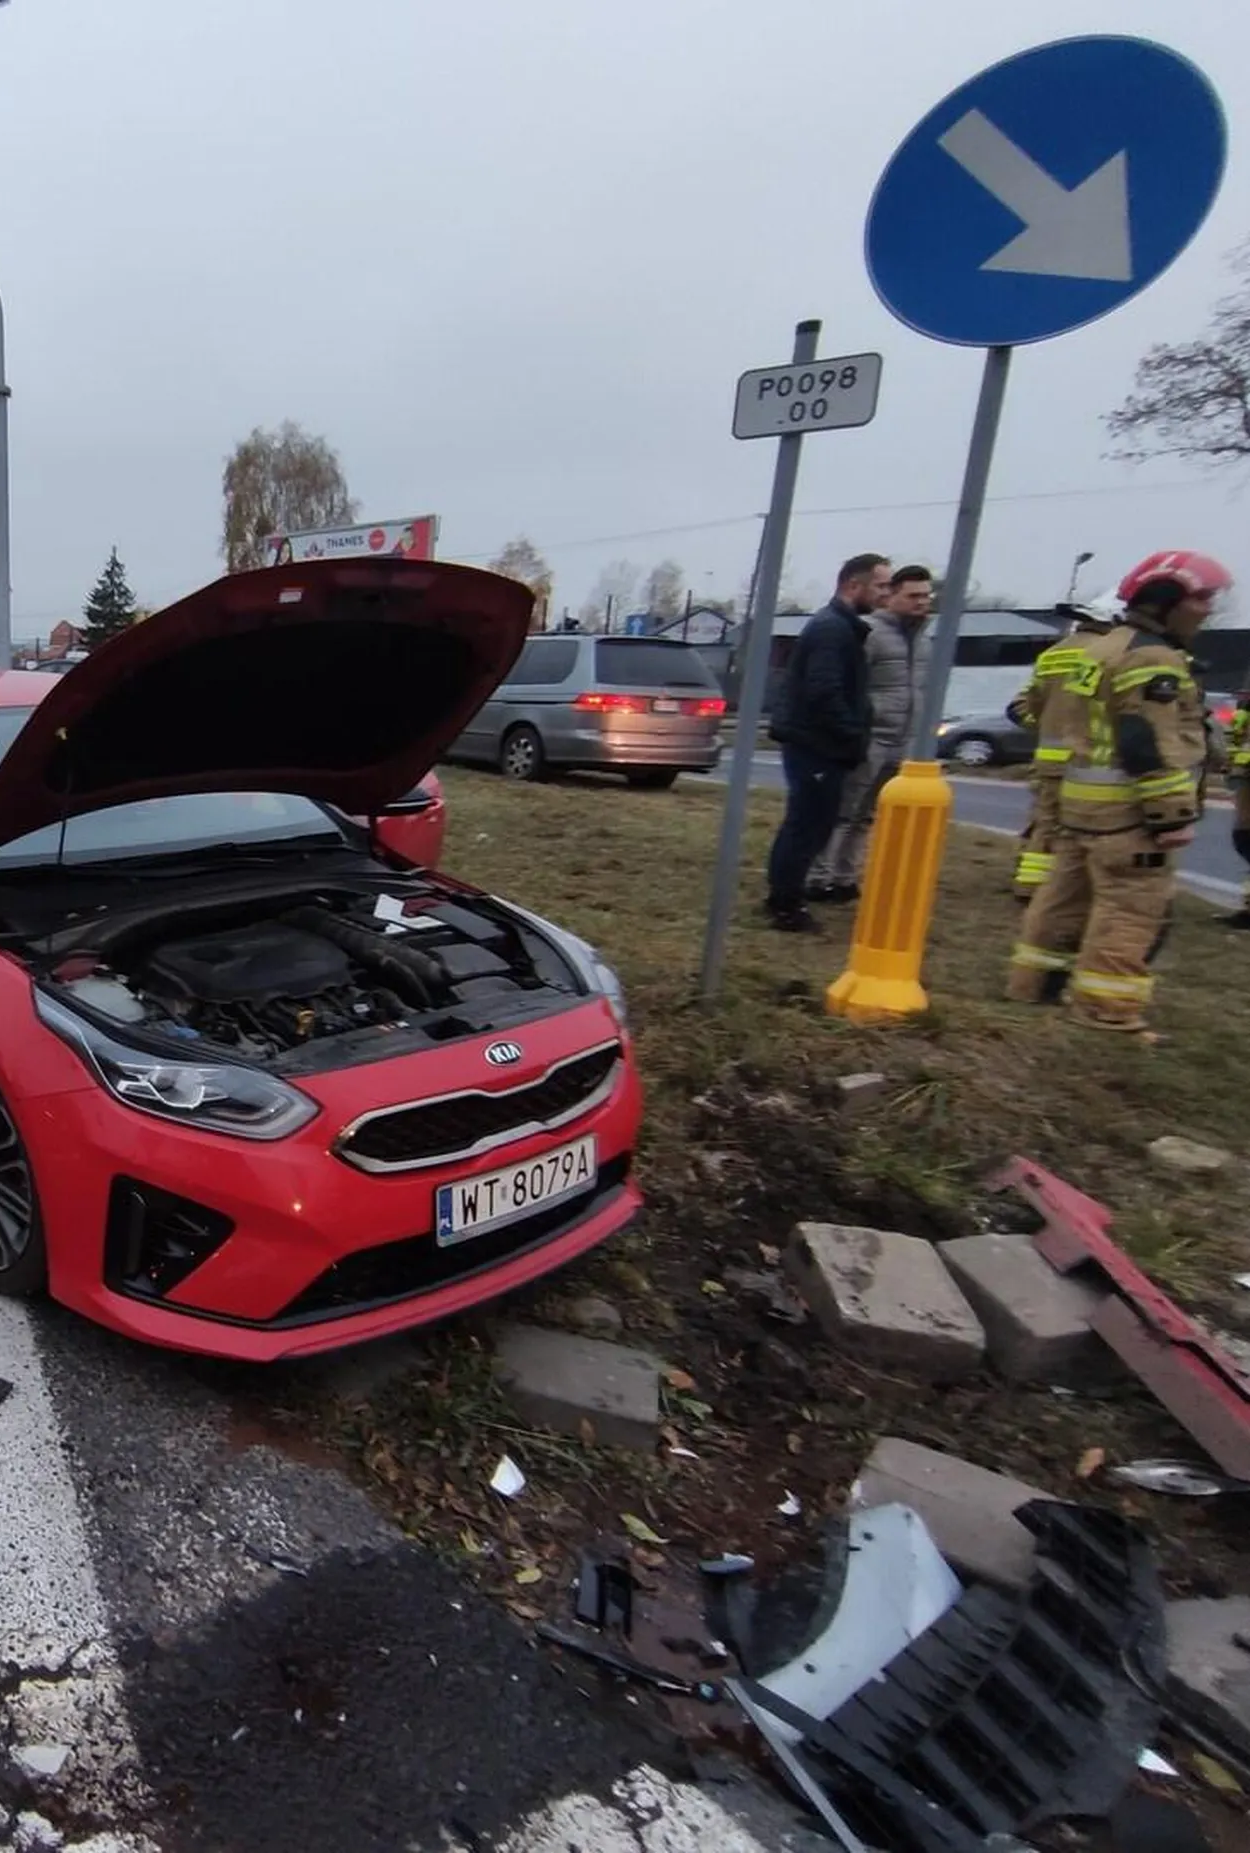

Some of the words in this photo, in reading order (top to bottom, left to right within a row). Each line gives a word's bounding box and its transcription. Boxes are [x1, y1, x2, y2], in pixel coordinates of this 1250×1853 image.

[489, 1042, 522, 1064] KIA
[461, 1178, 500, 1225] WT
[513, 1144, 589, 1207] 8079A
